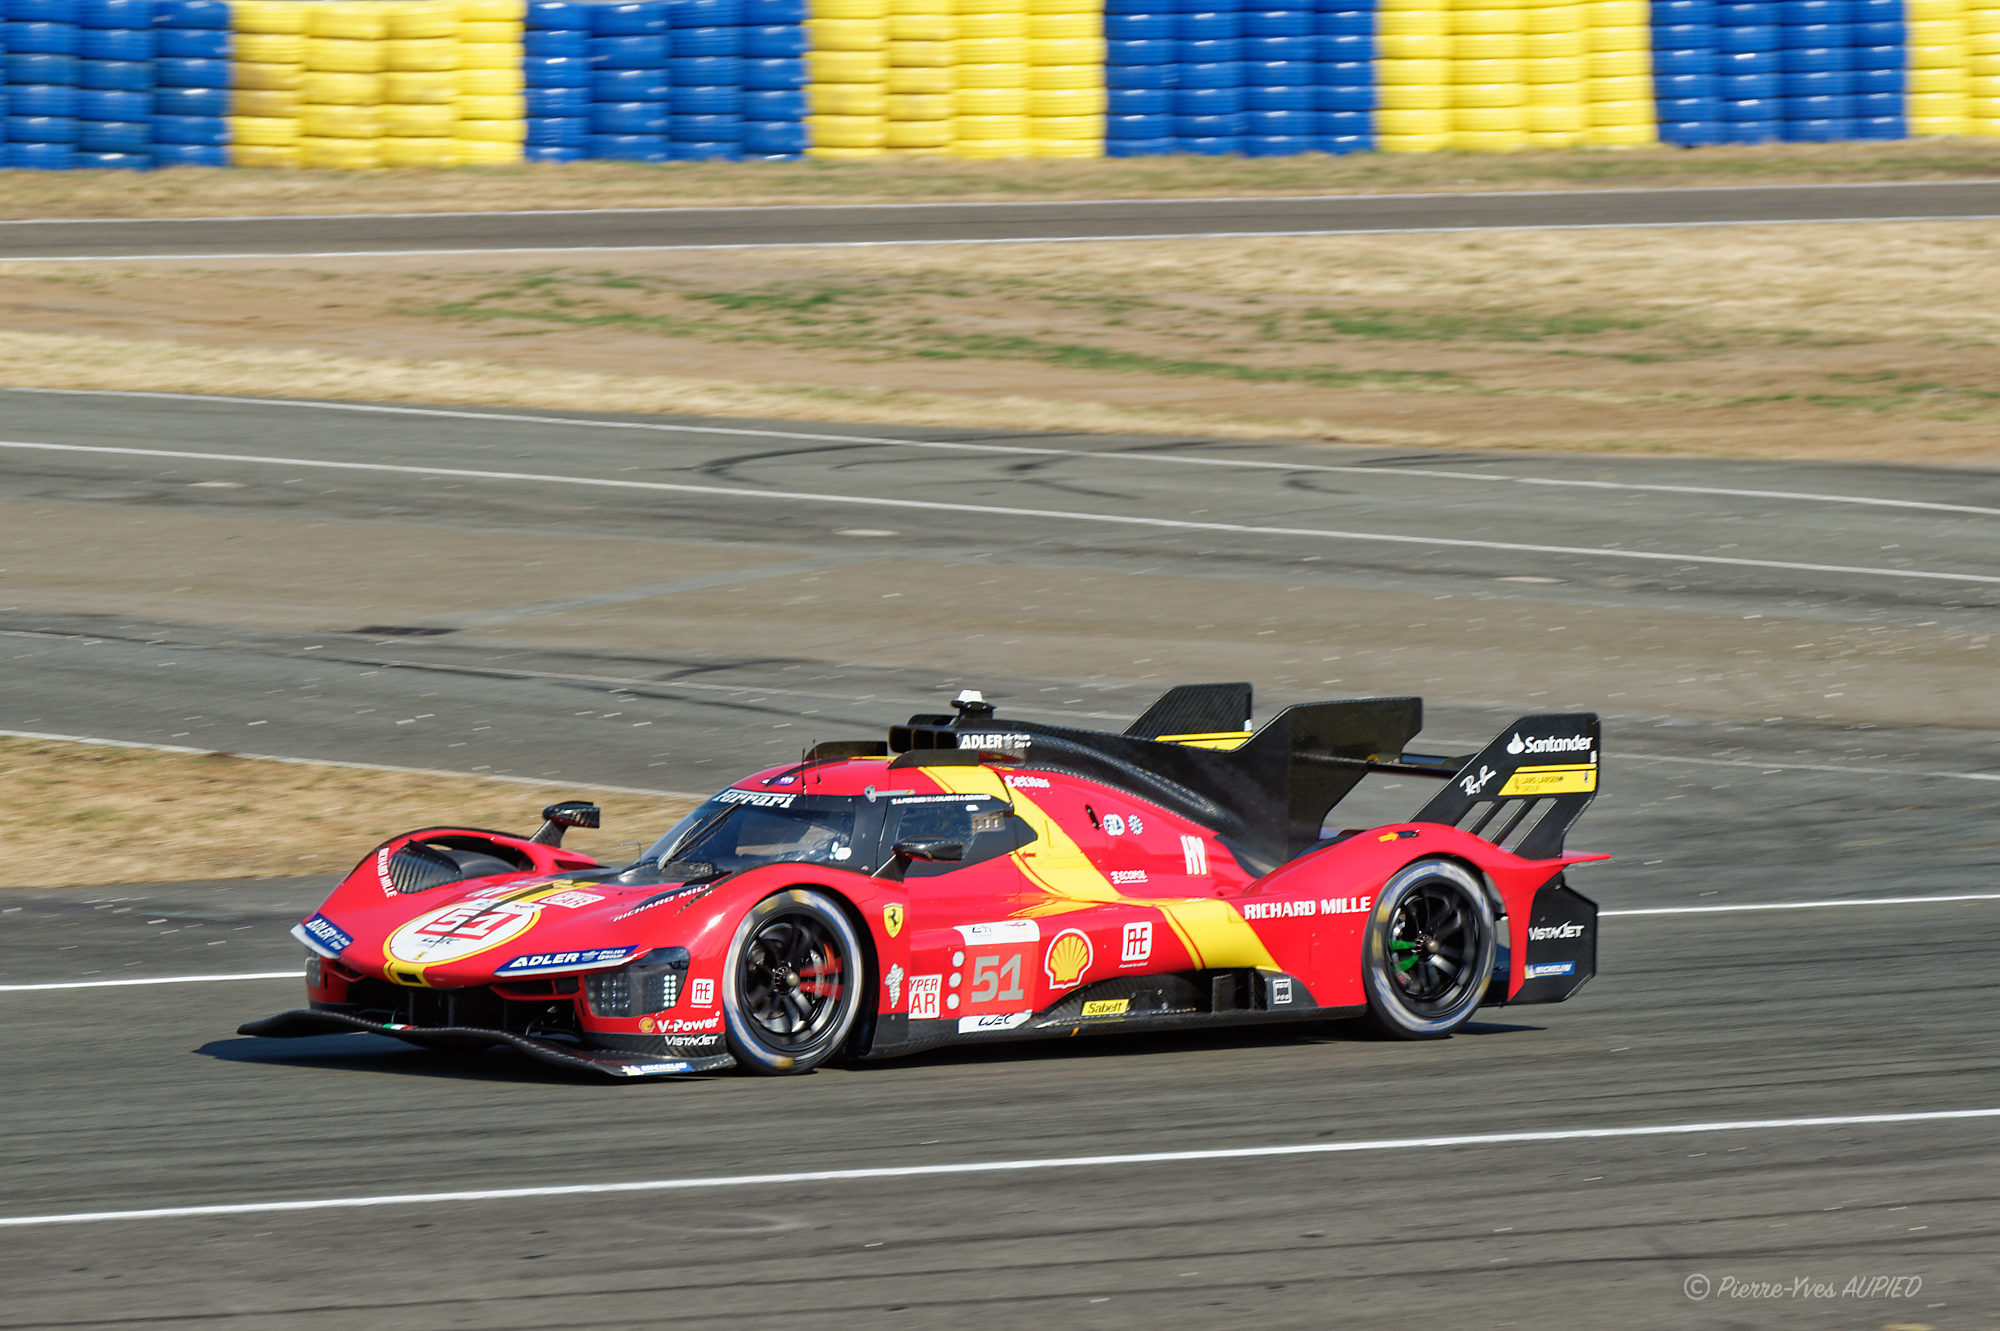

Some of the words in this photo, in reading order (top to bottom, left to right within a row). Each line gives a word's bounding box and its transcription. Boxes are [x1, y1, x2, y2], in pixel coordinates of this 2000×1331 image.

[959, 734, 1003, 750] ADLER
[1525, 734, 1593, 754] Santander
[711, 788, 798, 809] Ferrari
[379, 874, 398, 898] MILLE
[1243, 900, 1317, 920] RICHARD
[1320, 896, 1372, 915] MILLE
[305, 918, 338, 941] ADLER
[415, 907, 522, 940] 51
[509, 952, 580, 968] ADLER
[909, 978, 938, 992] YPER
[971, 953, 1025, 1003] 51
[910, 992, 936, 1014] AR
[1087, 1001, 1123, 1014] Sabelt
[656, 1015, 720, 1033] V-Power
